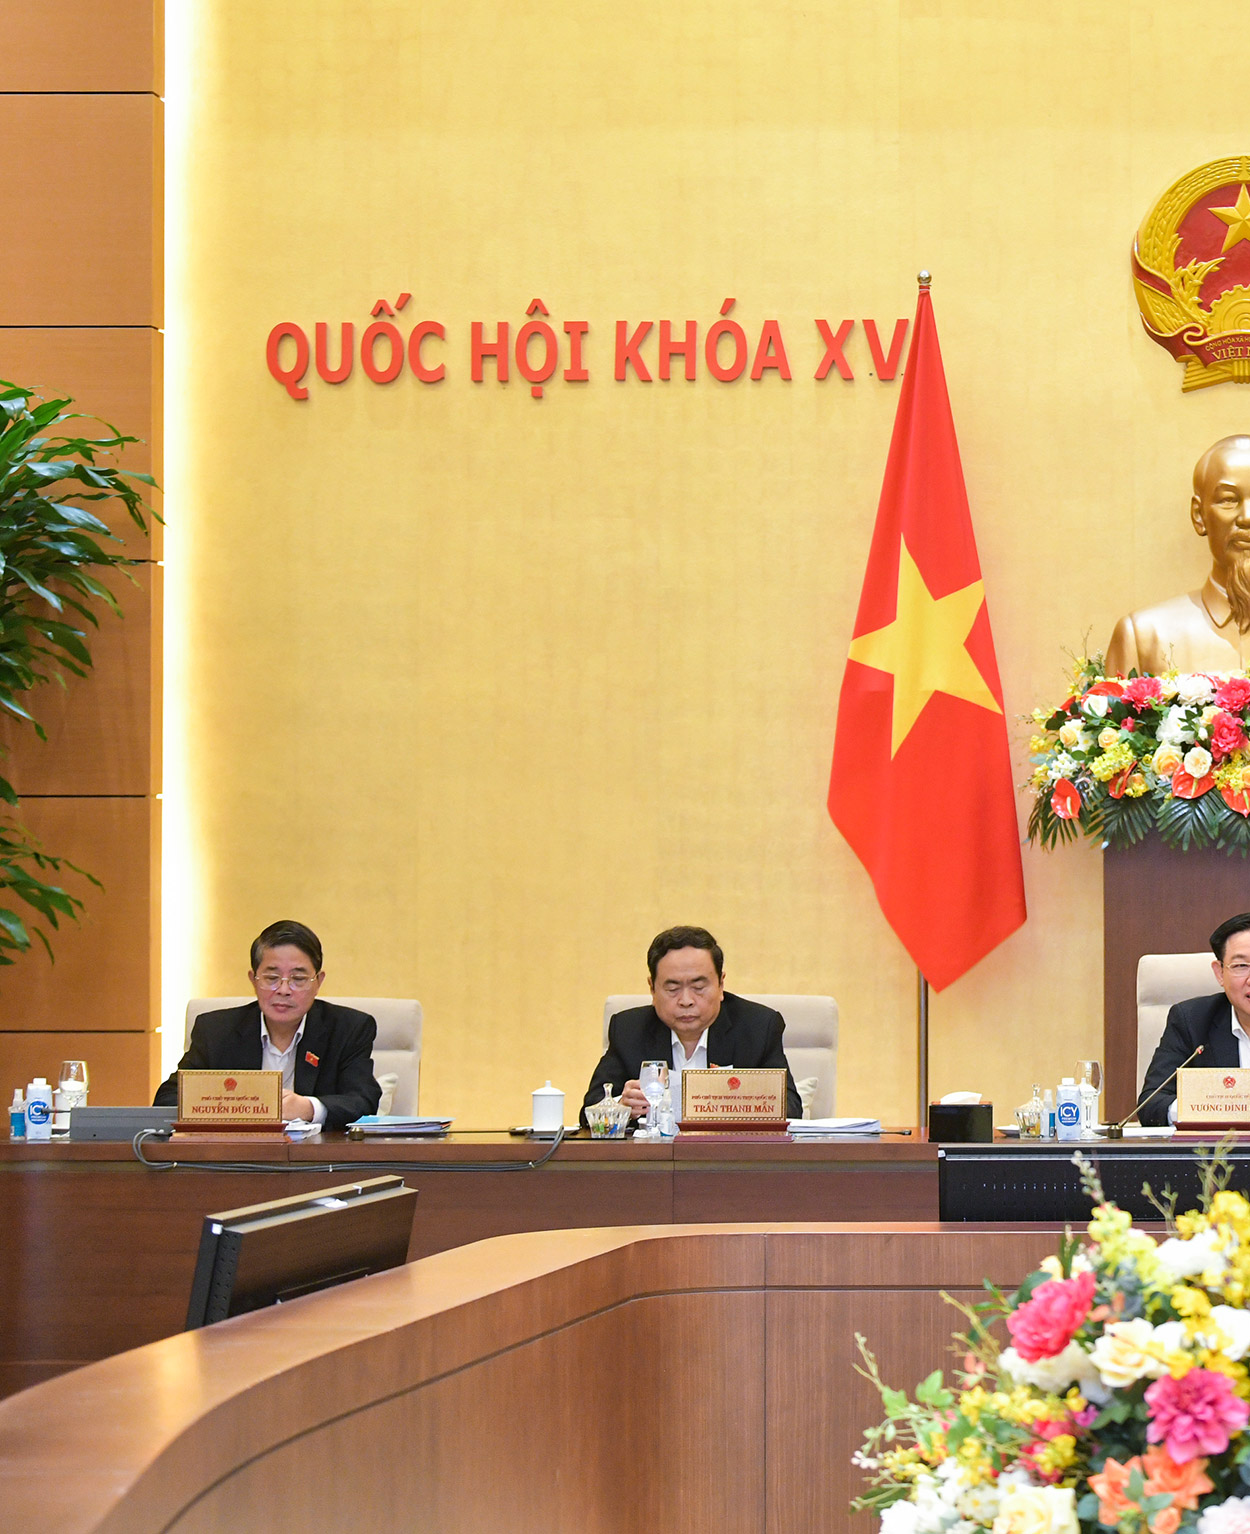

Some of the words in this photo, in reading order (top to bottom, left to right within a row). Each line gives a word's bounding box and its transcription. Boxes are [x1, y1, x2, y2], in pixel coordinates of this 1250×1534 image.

[267, 293, 446, 400] QUỐC
[472, 298, 589, 398] HỘI
[615, 298, 793, 382] KHÓA
[814, 319, 909, 381] XV
[720, 1104, 752, 1113] THANH
[1060, 1106, 1078, 1117] ICY
